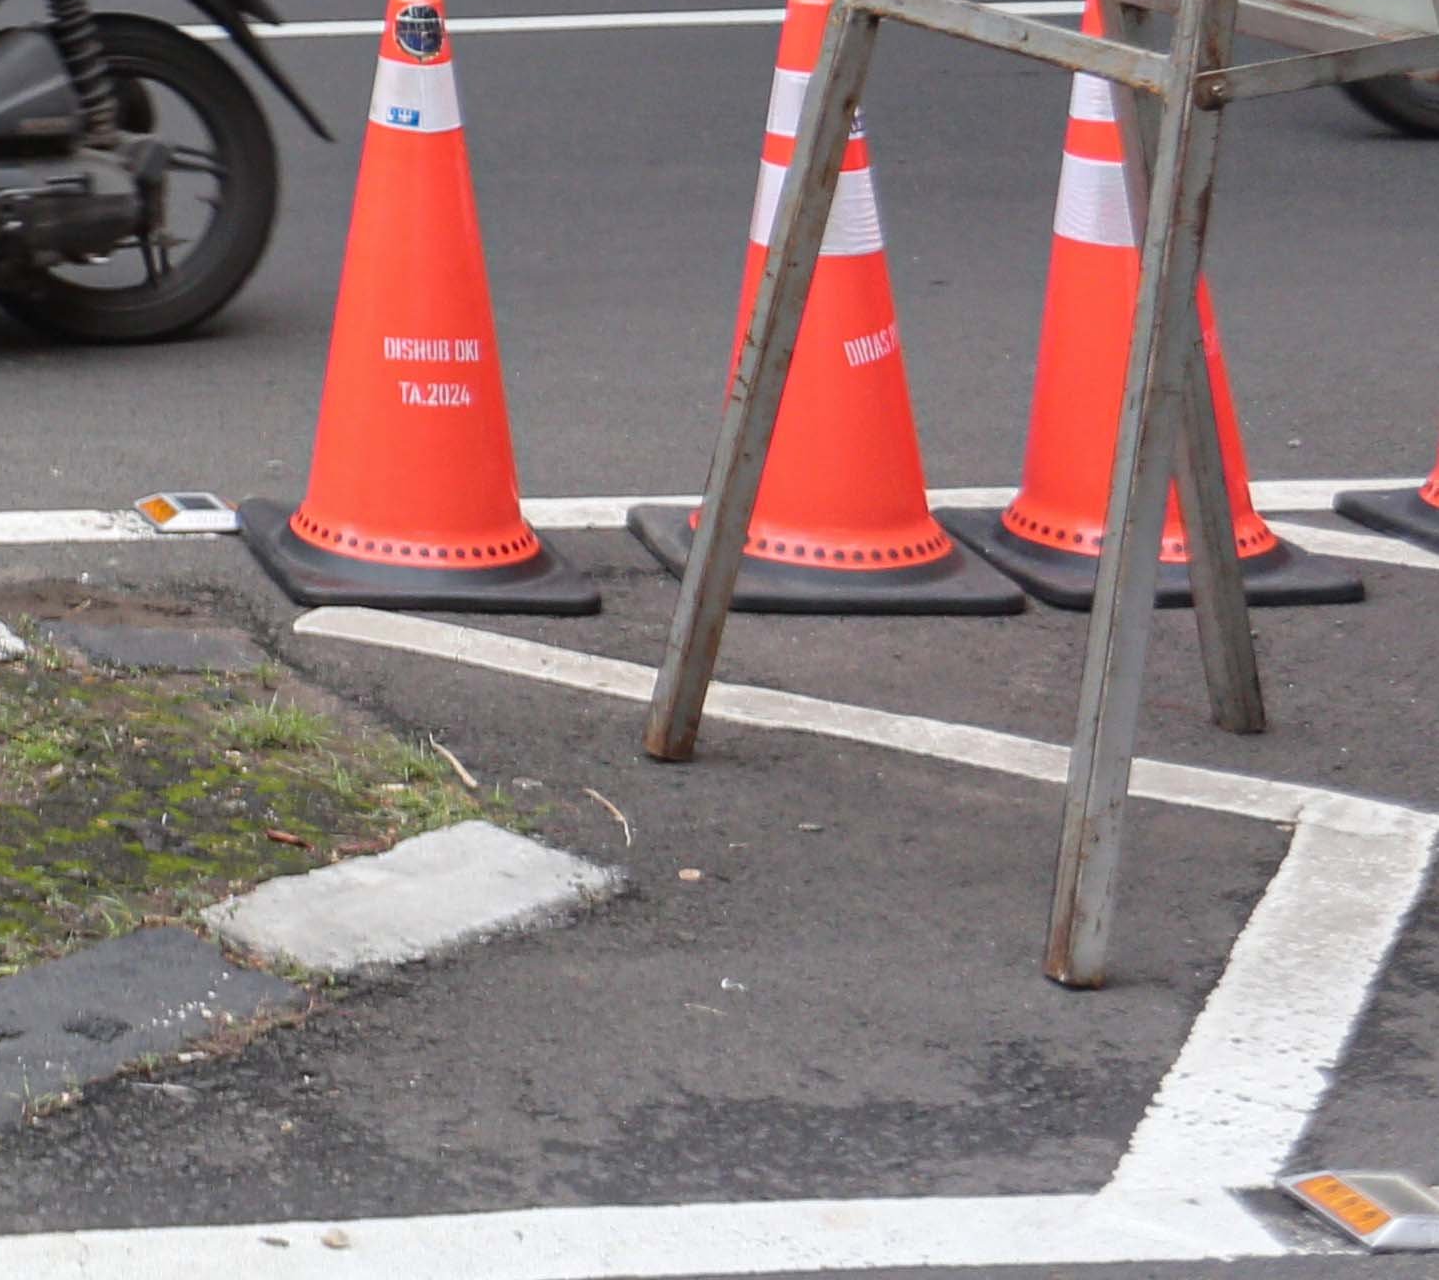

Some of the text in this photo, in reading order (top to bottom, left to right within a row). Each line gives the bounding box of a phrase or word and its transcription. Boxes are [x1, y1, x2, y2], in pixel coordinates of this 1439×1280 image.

[383, 336, 480, 362] DISHUB DKI
[843, 328, 891, 367] DINAS
[398, 380, 471, 407] TA.2024
